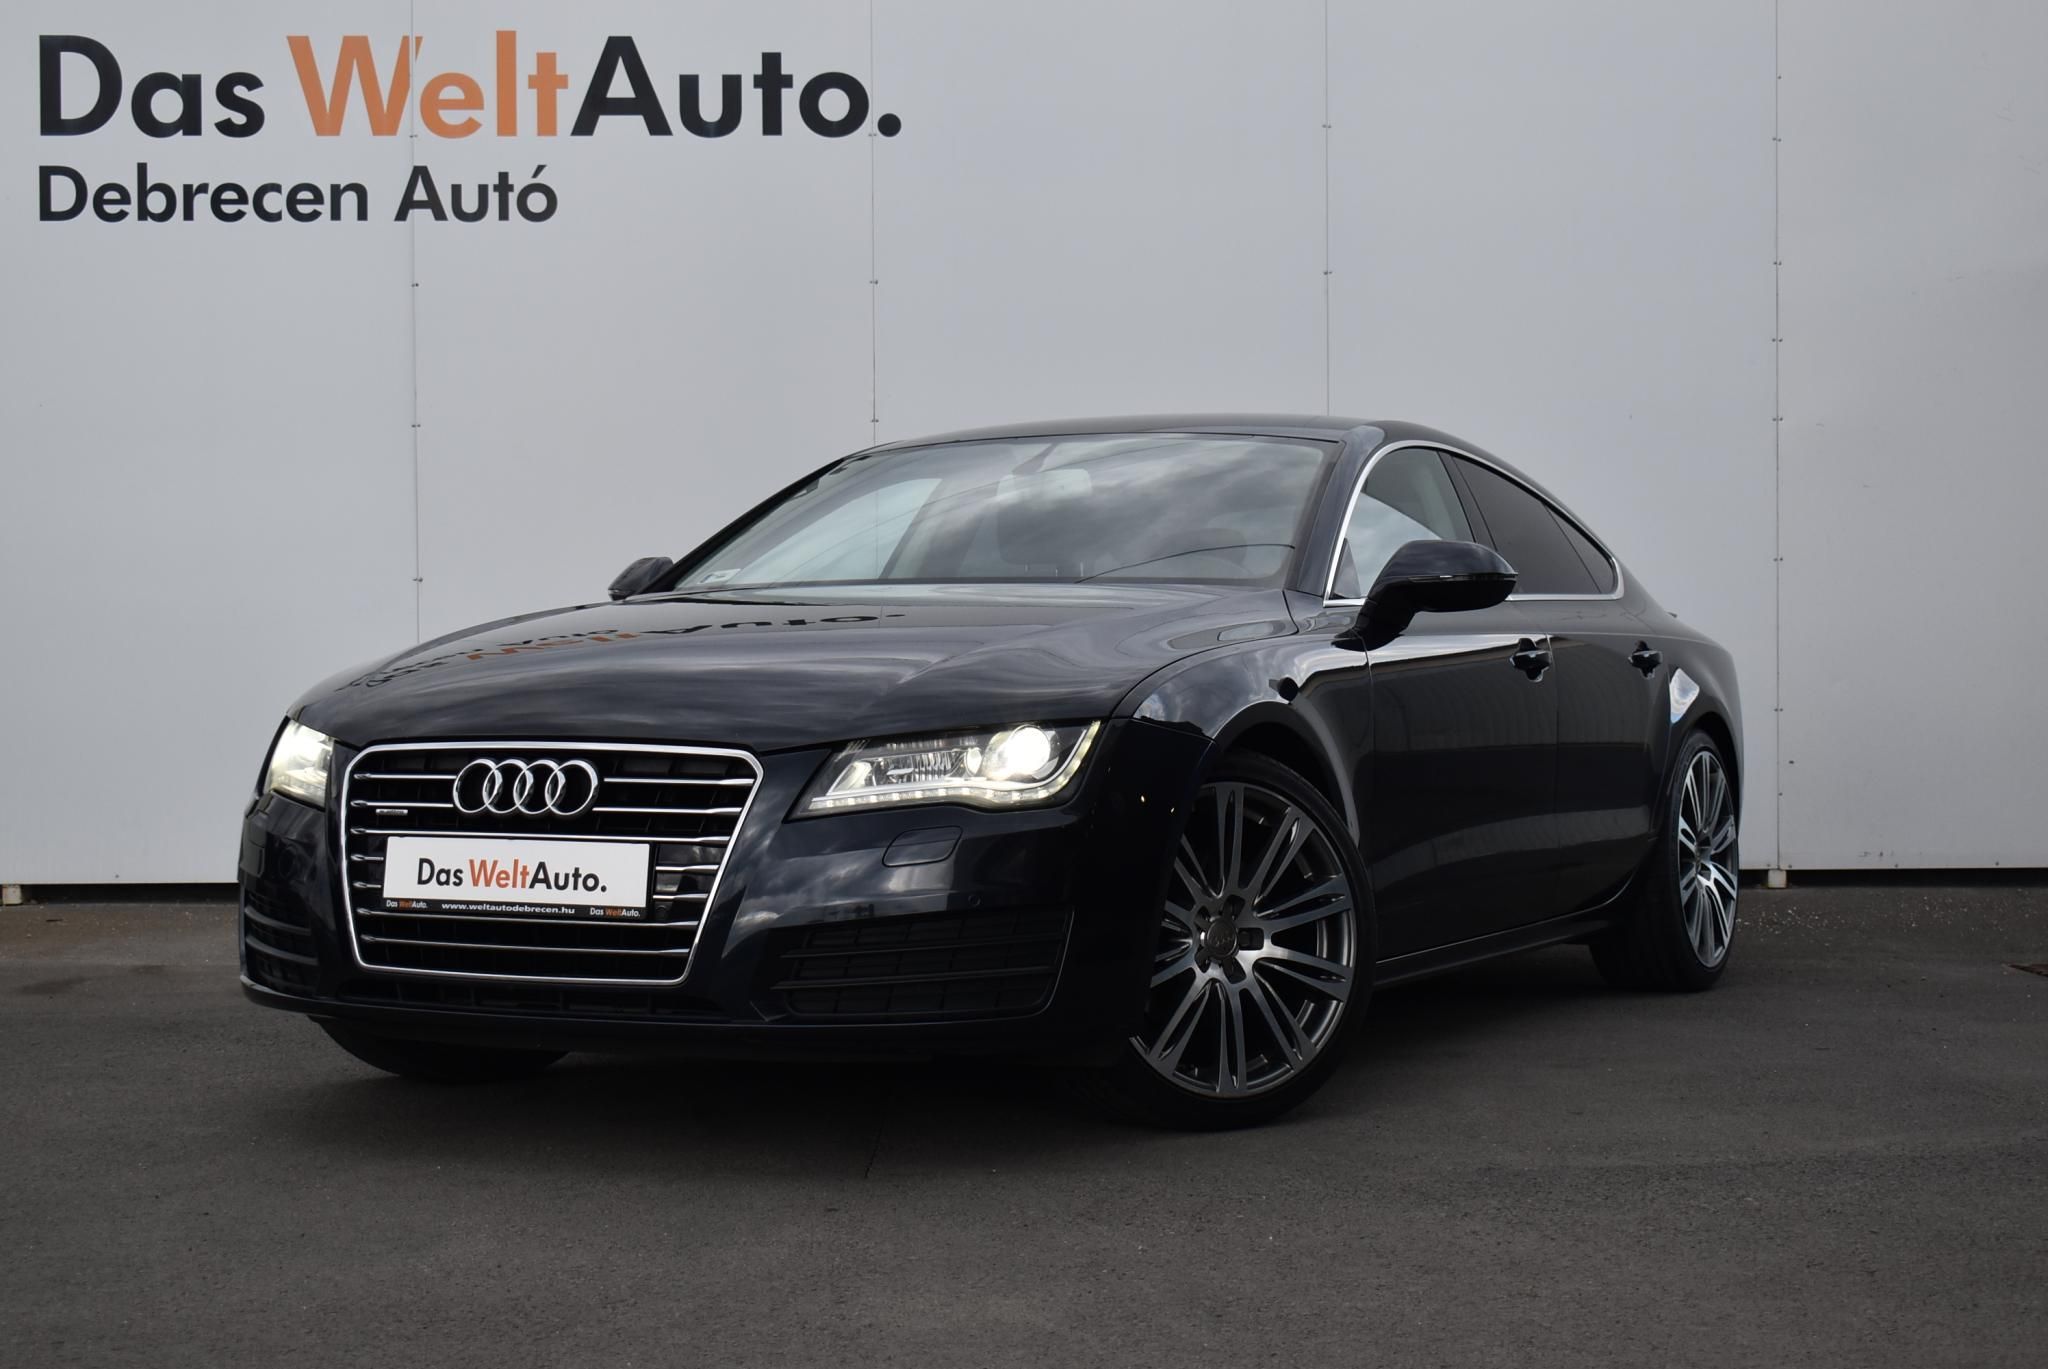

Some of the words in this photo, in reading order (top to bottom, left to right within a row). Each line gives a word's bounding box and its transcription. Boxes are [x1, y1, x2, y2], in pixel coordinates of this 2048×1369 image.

[38, 34, 265, 139] Das
[38, 162, 368, 223] Debrecen
[394, 164, 558, 223] Autó
[417, 857, 464, 887] Das
[386, 899, 398, 908] Das
[441, 902, 575, 914] www.weltautodebrecen.hu
[589, 907, 604, 916] Das
